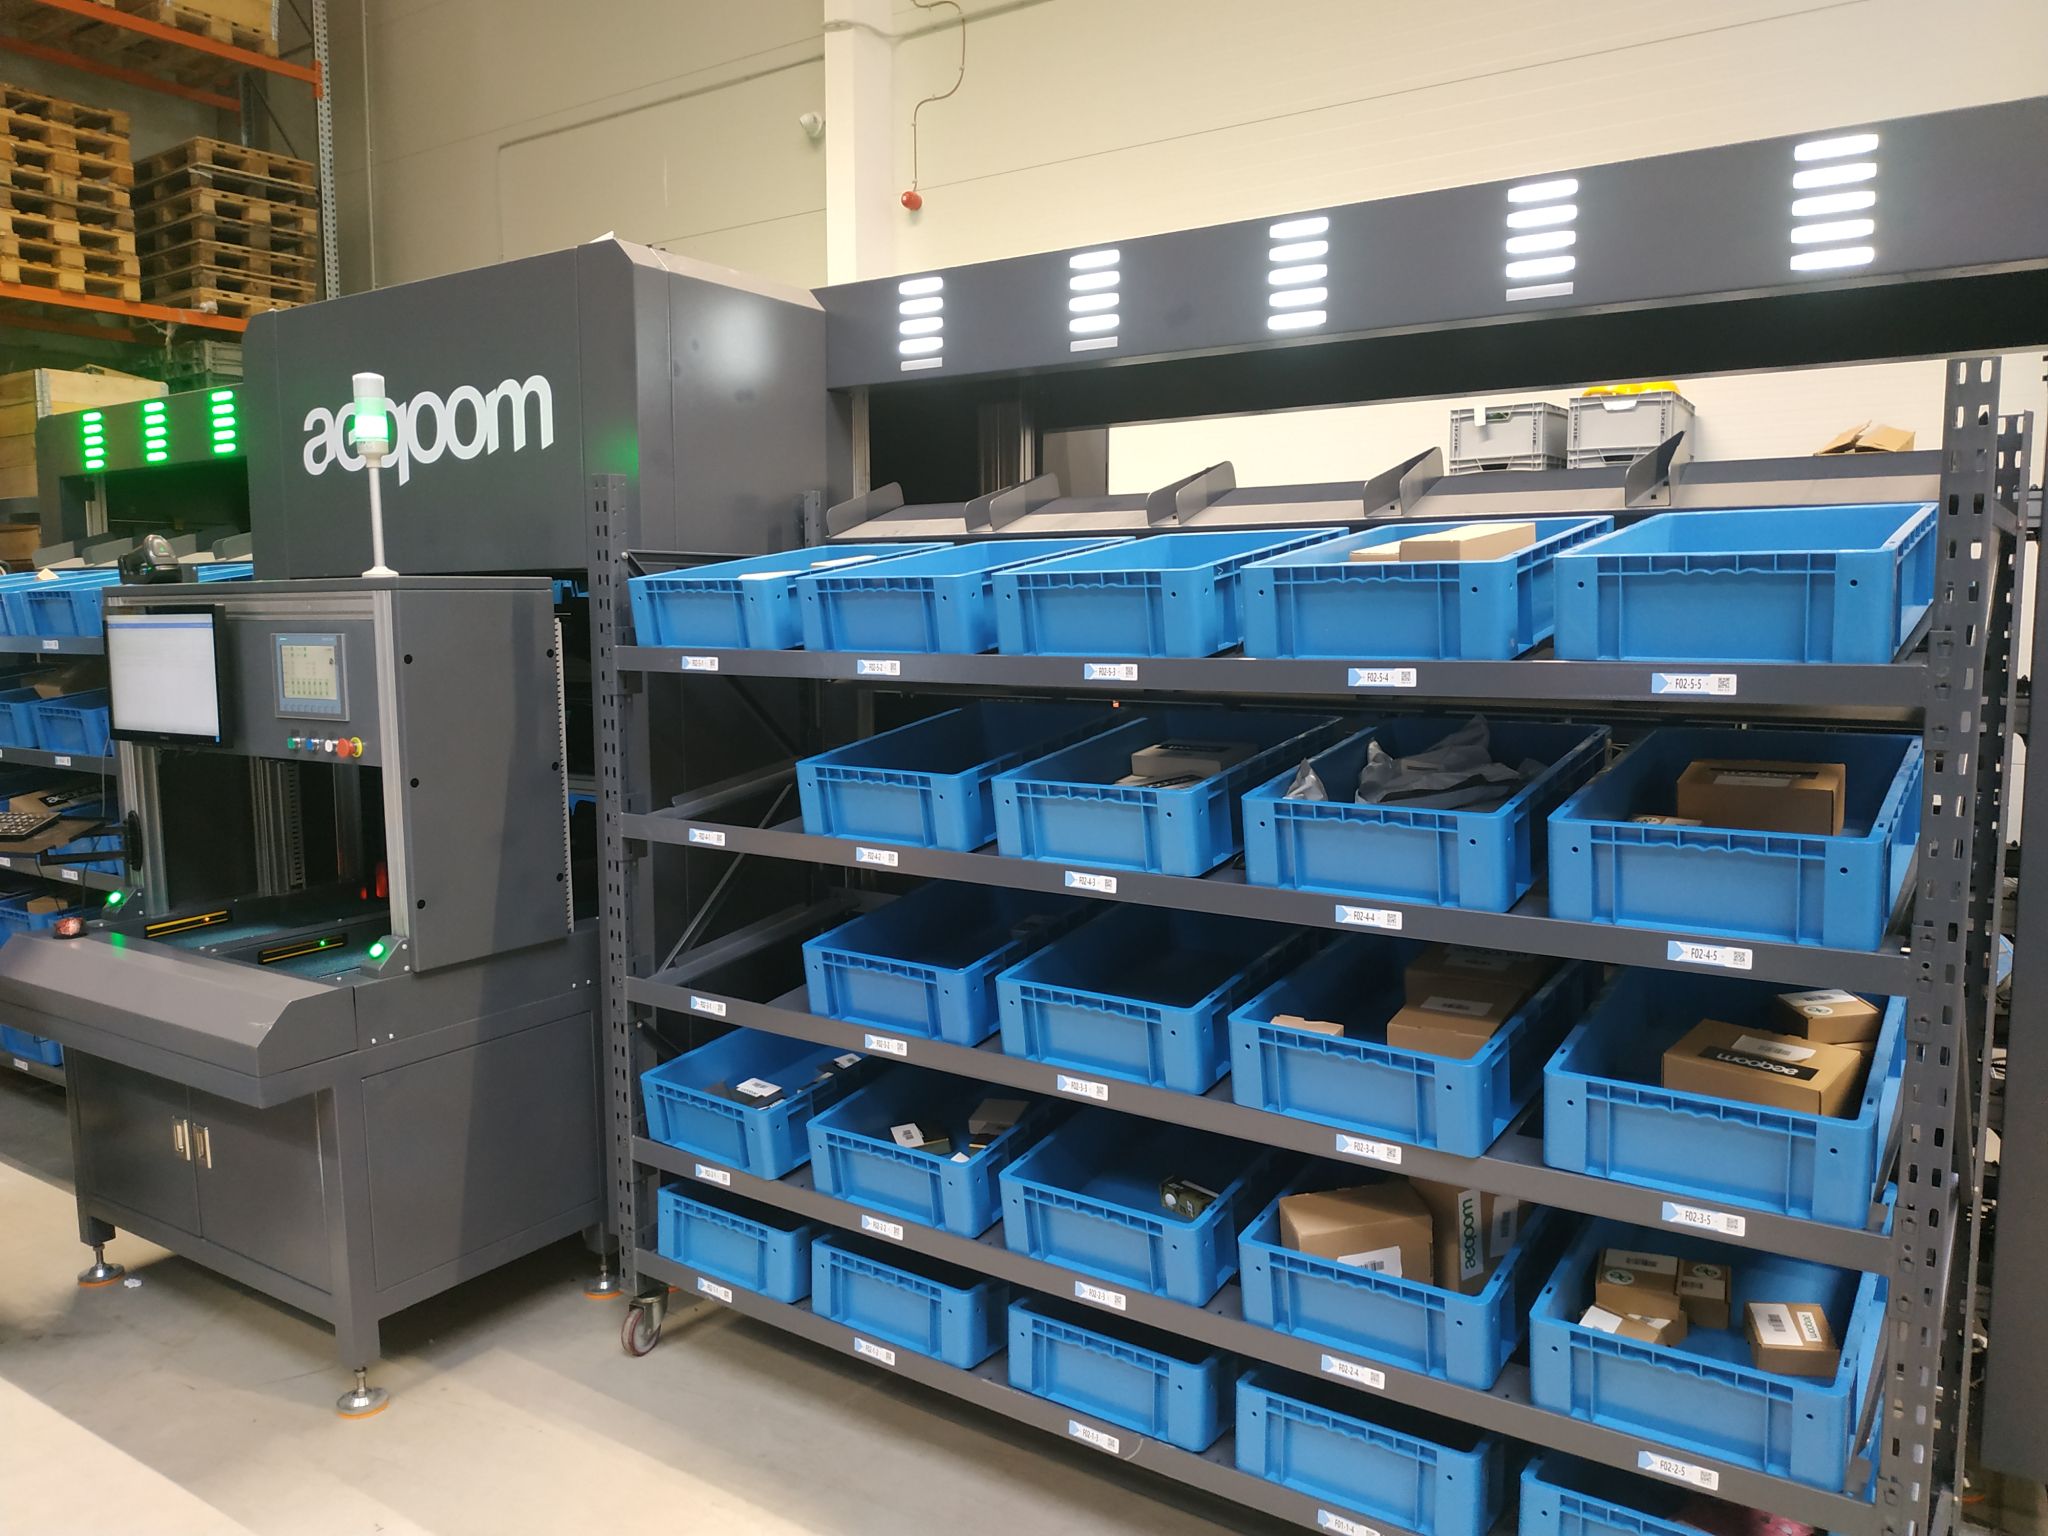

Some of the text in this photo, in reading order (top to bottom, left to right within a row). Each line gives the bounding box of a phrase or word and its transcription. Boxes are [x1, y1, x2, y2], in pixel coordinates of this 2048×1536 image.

[1098, 667, 1116, 676] F02-5-3
[1367, 672, 1389, 682] F02-5-4
[1675, 678, 1702, 689] F02-5-5
[1079, 876, 1095, 886] F02-4-3
[1353, 911, 1375, 922] F02-4-4
[1691, 948, 1717, 960] F02-4-5
[1071, 1081, 1087, 1093] F02-3-3
[1353, 1141, 1375, 1154] F02-3-4
[1685, 1210, 1711, 1225] F02-3-5
[1462, 1198, 1477, 1270] aeqoom
[1088, 1288, 1105, 1300] F02-2-3
[1338, 1363, 1359, 1377] F02-2-4
[1082, 1428, 1099, 1442] F02-1-3
[1660, 1461, 1685, 1476] F02-2-5
